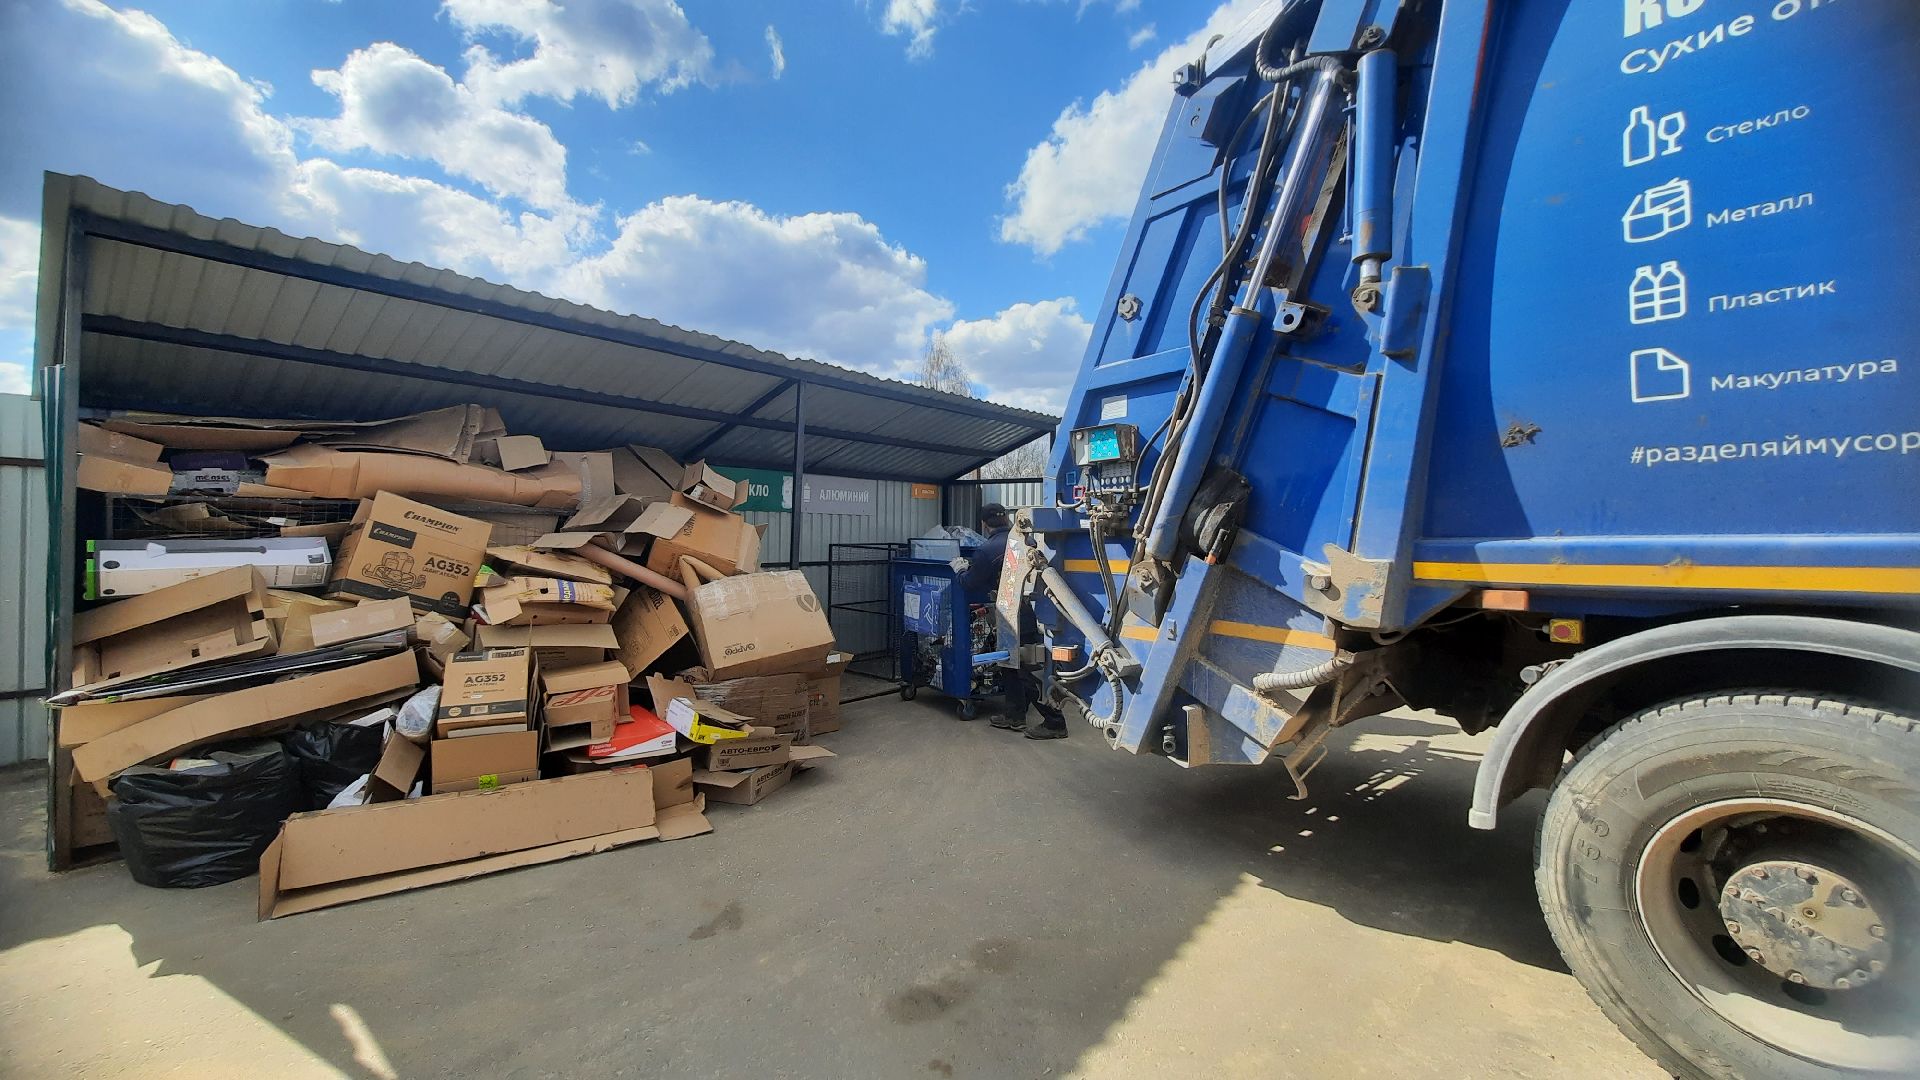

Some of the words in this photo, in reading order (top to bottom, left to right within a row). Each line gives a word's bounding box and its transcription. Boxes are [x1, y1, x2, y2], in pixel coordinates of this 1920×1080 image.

[1620, 14, 1755, 75] Сухие
[1705, 105, 1810, 143] Стекло
[1706, 192, 1814, 228] Металл
[1708, 280, 1837, 312] Пластик
[1711, 359, 1898, 391] Макулатура
[749, 484, 769, 497] КЛО
[819, 488, 869, 502] АЛЮМИНИЙ
[425, 557, 470, 577] AG352
[464, 674, 506, 684] AG352
[720, 746, 771, 755] АВТО-ЕВРО
